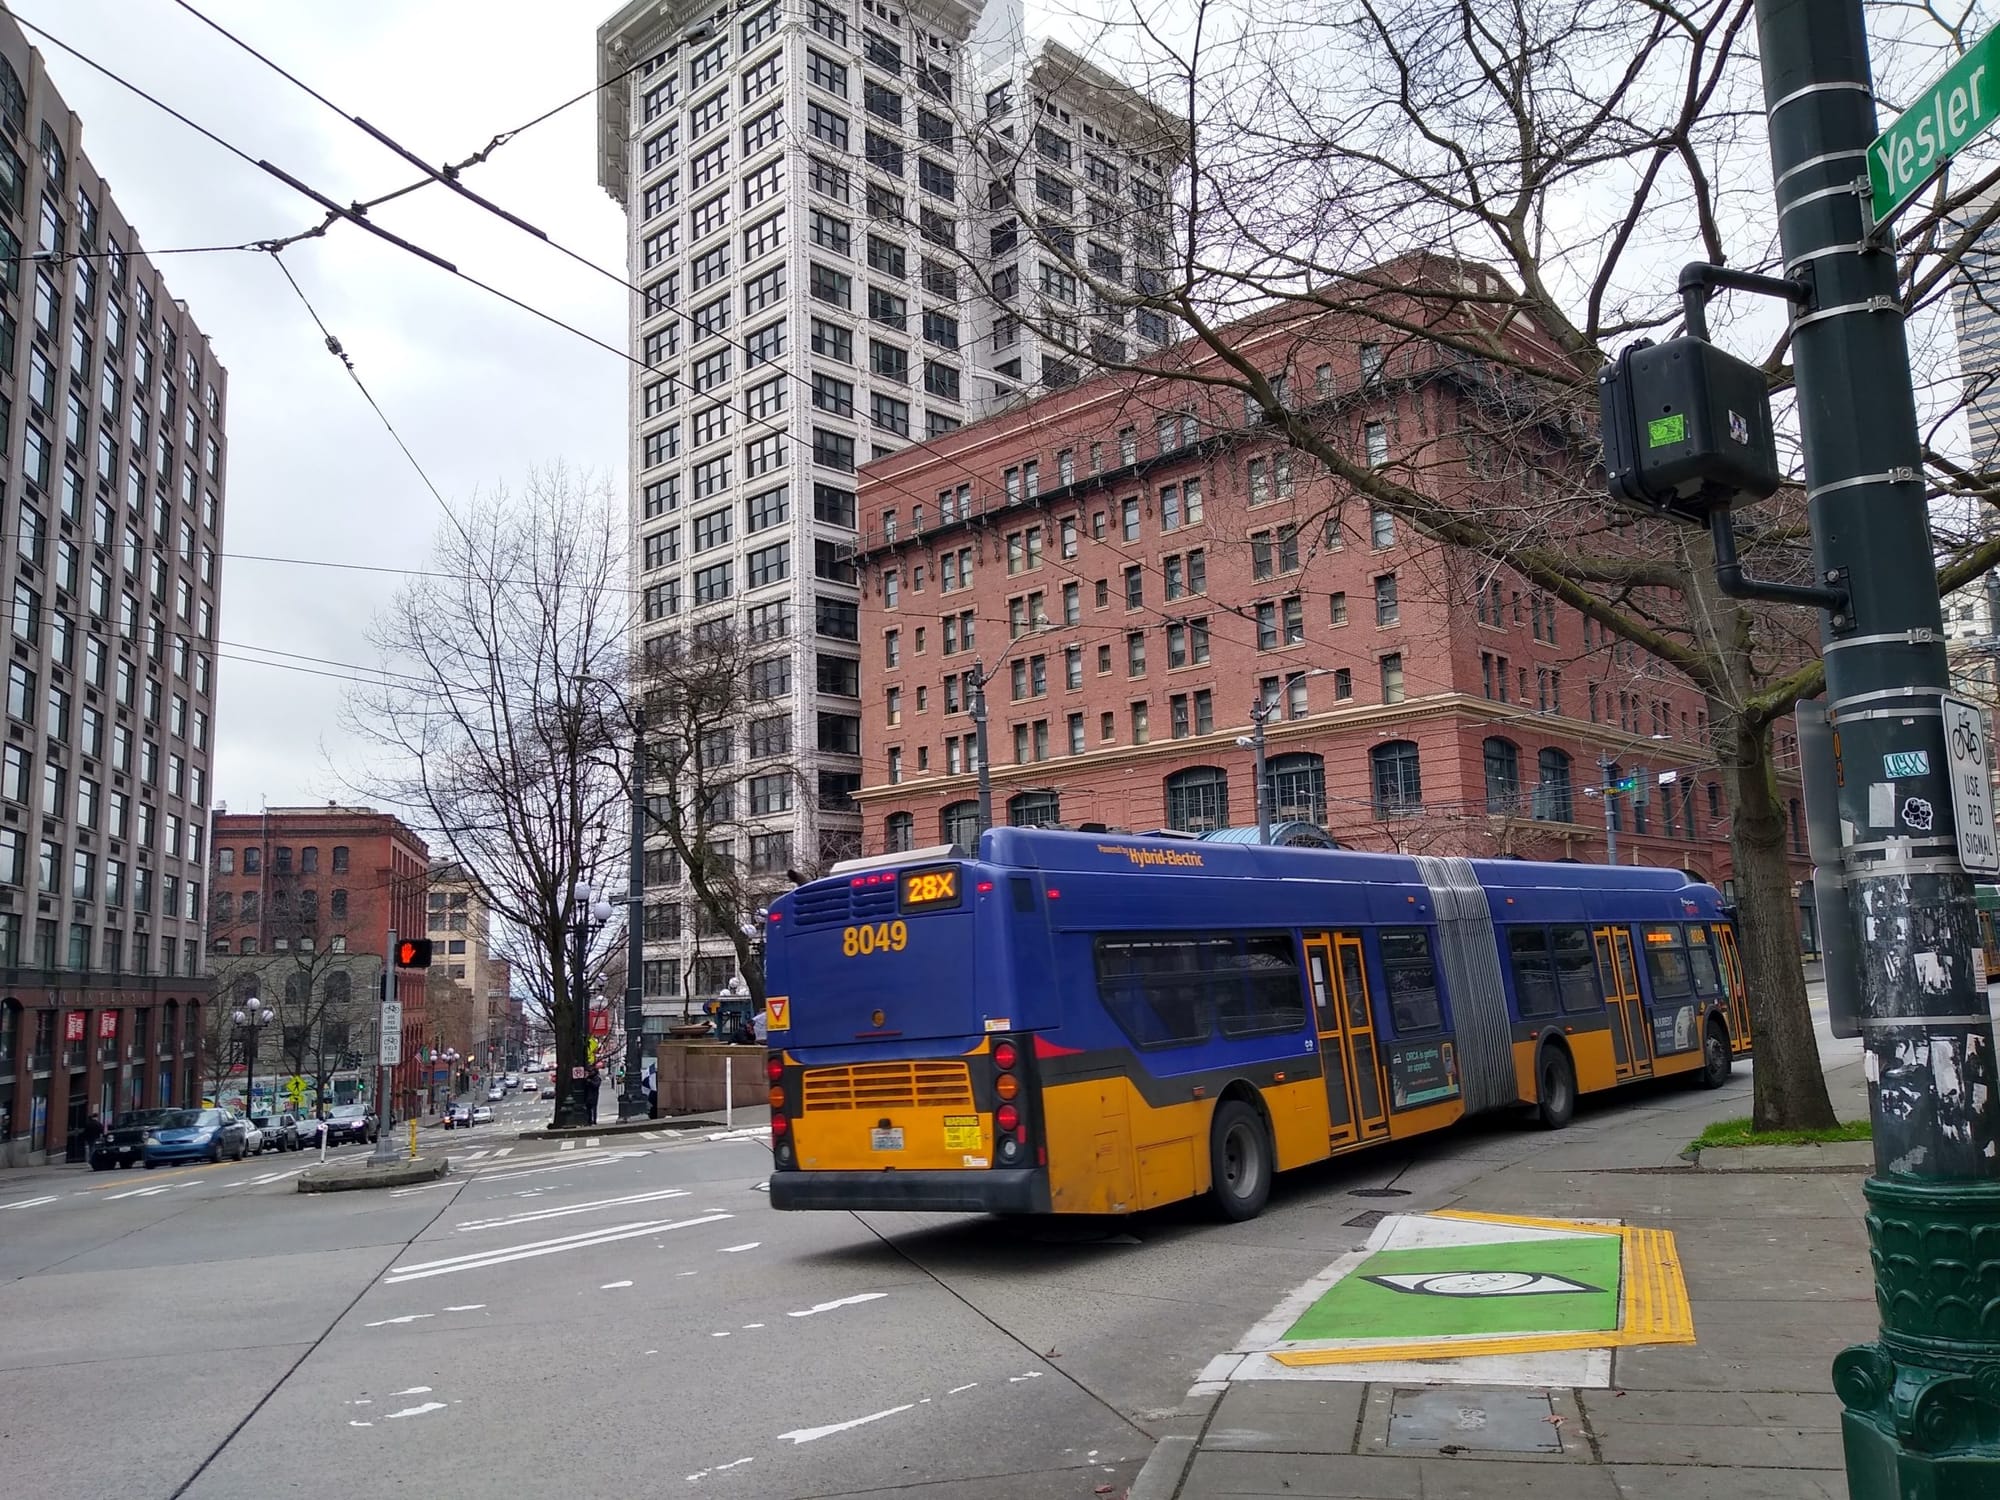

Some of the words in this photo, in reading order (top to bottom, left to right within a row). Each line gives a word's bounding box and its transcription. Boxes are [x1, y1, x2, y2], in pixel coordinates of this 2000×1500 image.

[1877, 64, 1985, 196] Yesler
[1964, 773, 1980, 797] USE
[1967, 803, 1984, 826] PED
[1965, 832, 1993, 856] SIGNAL
[1128, 847, 1204, 868] Hybrid-Electric
[908, 873, 954, 902] 28X
[843, 920, 908, 957] 8049
[68, 1014, 76, 1038] LEASING
[75, 1018, 84, 1034] NOW
[101, 1013, 110, 1036] LEASING
